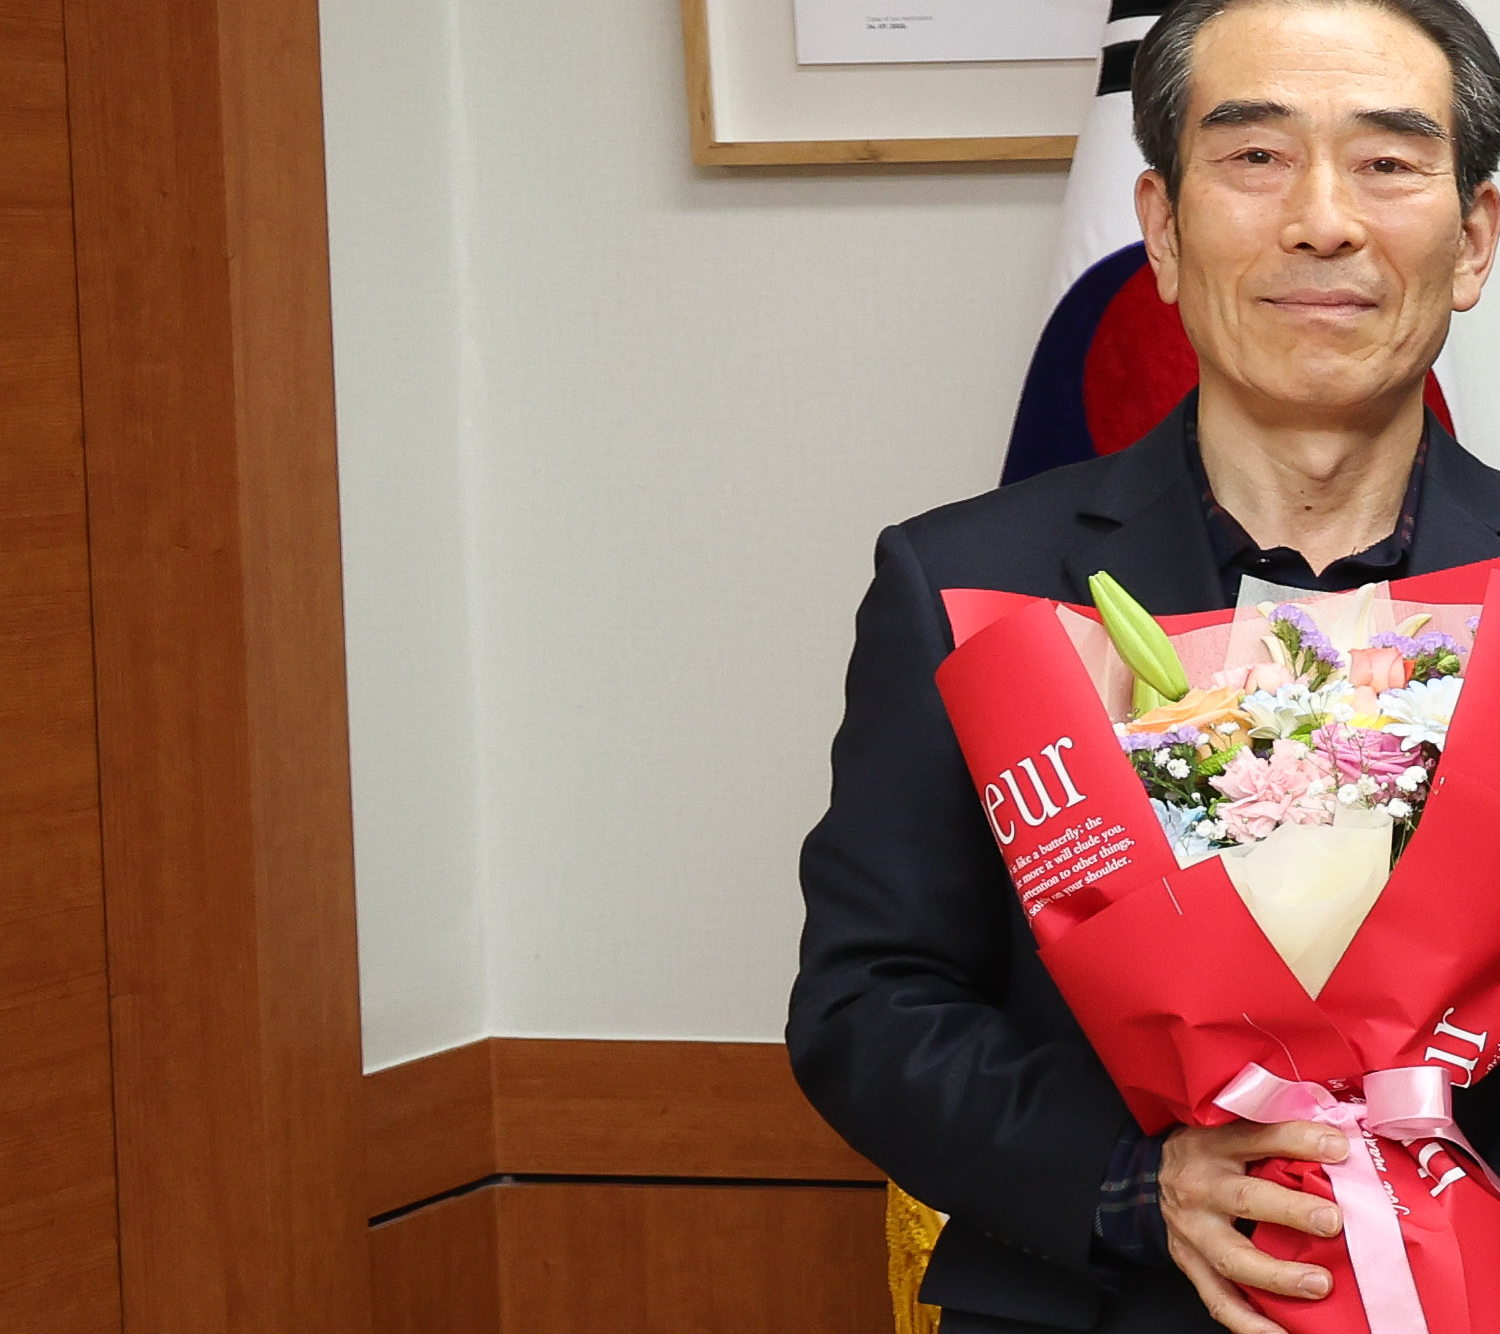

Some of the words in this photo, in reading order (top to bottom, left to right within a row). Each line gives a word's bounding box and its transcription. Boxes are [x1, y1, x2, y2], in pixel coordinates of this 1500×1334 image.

[1084, 816, 1104, 832] the
[1053, 846, 1073, 867] will
[1101, 825, 1126, 843] you.
[1060, 868, 1071, 880] to
[1071, 854, 1099, 873] other
[1084, 856, 1132, 885] shoulder.
